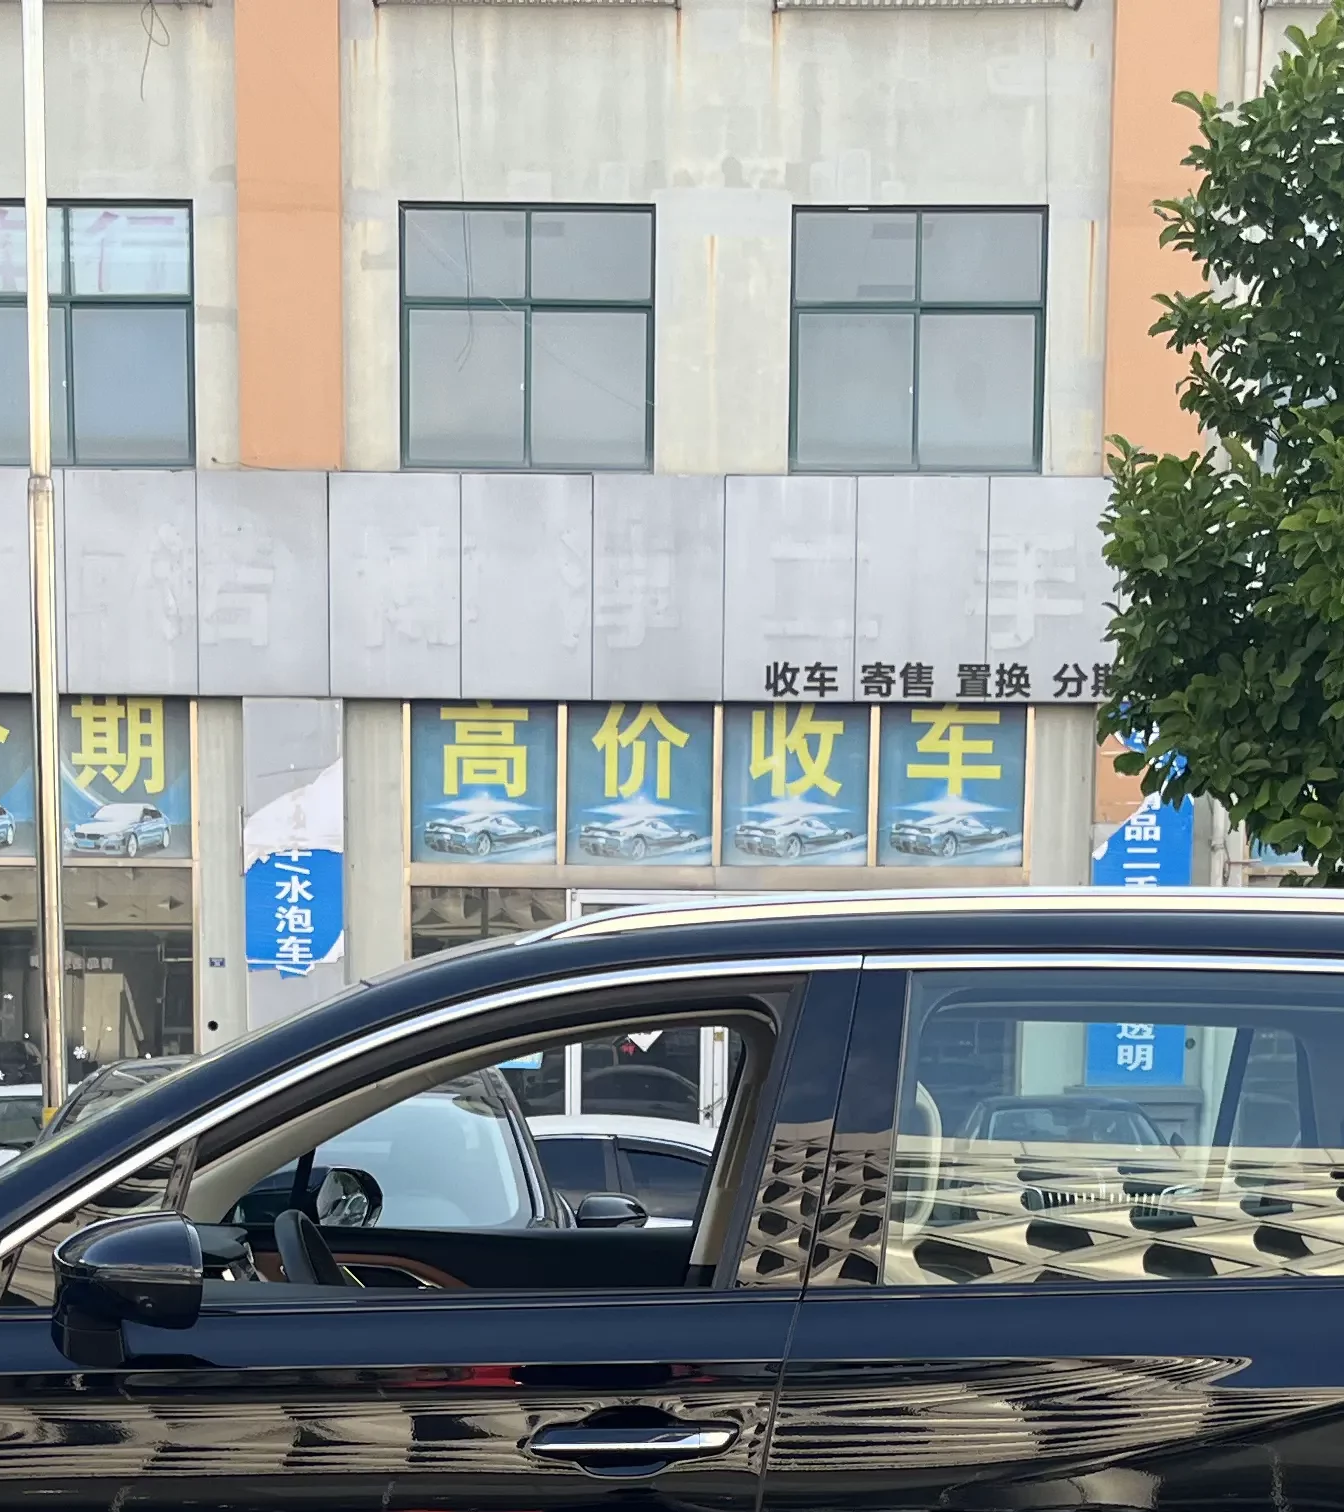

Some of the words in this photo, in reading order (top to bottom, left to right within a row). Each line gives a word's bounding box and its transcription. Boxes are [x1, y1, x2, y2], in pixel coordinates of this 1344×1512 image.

[764, 661, 839, 698] 收车
[859, 662, 935, 698] 寄售
[955, 663, 1032, 699] 置换
[439, 700, 1003, 800] 高价收车
